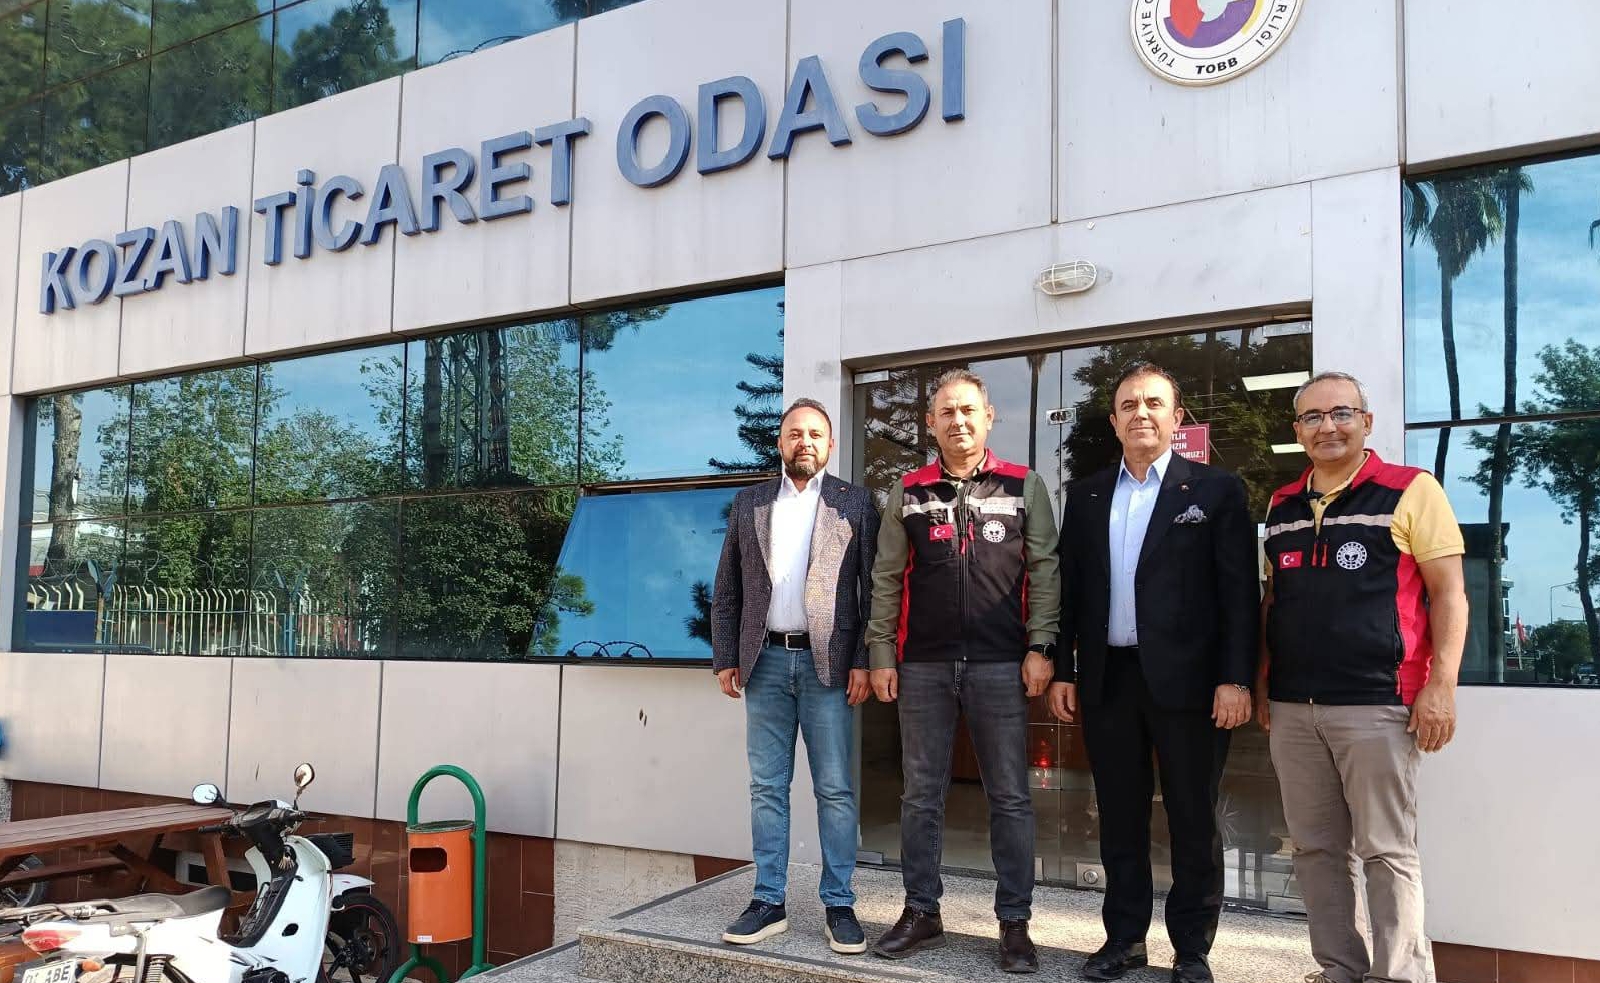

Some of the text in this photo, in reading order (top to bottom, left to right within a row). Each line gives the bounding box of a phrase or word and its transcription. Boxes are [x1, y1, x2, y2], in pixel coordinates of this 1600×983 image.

[1141, 11, 1175, 68] TÜRKİYE
[1255, 4, 1287, 47] RLİĞİ
[1195, 56, 1238, 75] TOBB
[39, 17, 966, 314] KOZAN TİCARET ODASI
